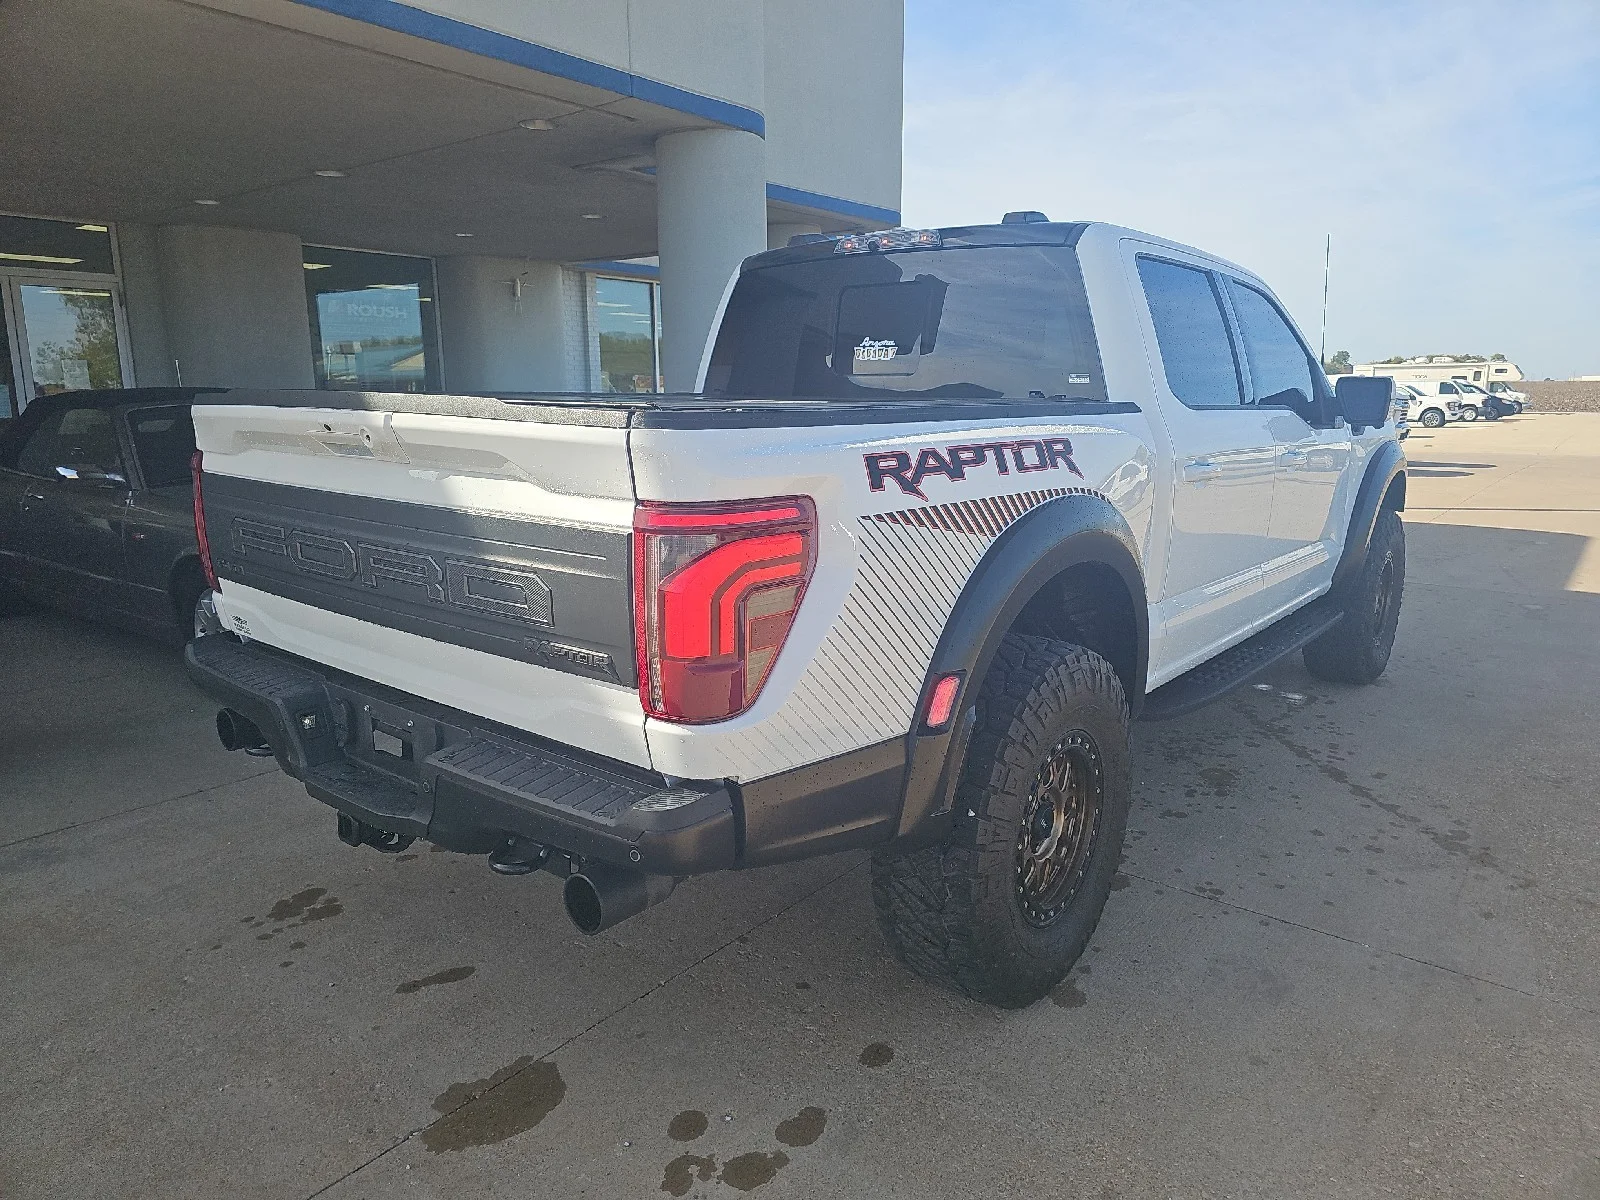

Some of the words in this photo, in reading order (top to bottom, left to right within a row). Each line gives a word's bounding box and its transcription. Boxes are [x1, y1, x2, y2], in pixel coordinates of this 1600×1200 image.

[346, 302, 407, 319] ROUSH
[862, 437, 1085, 502] RAPTOR
[230, 516, 555, 629] FORD
[524, 635, 622, 684] RAPTOR
